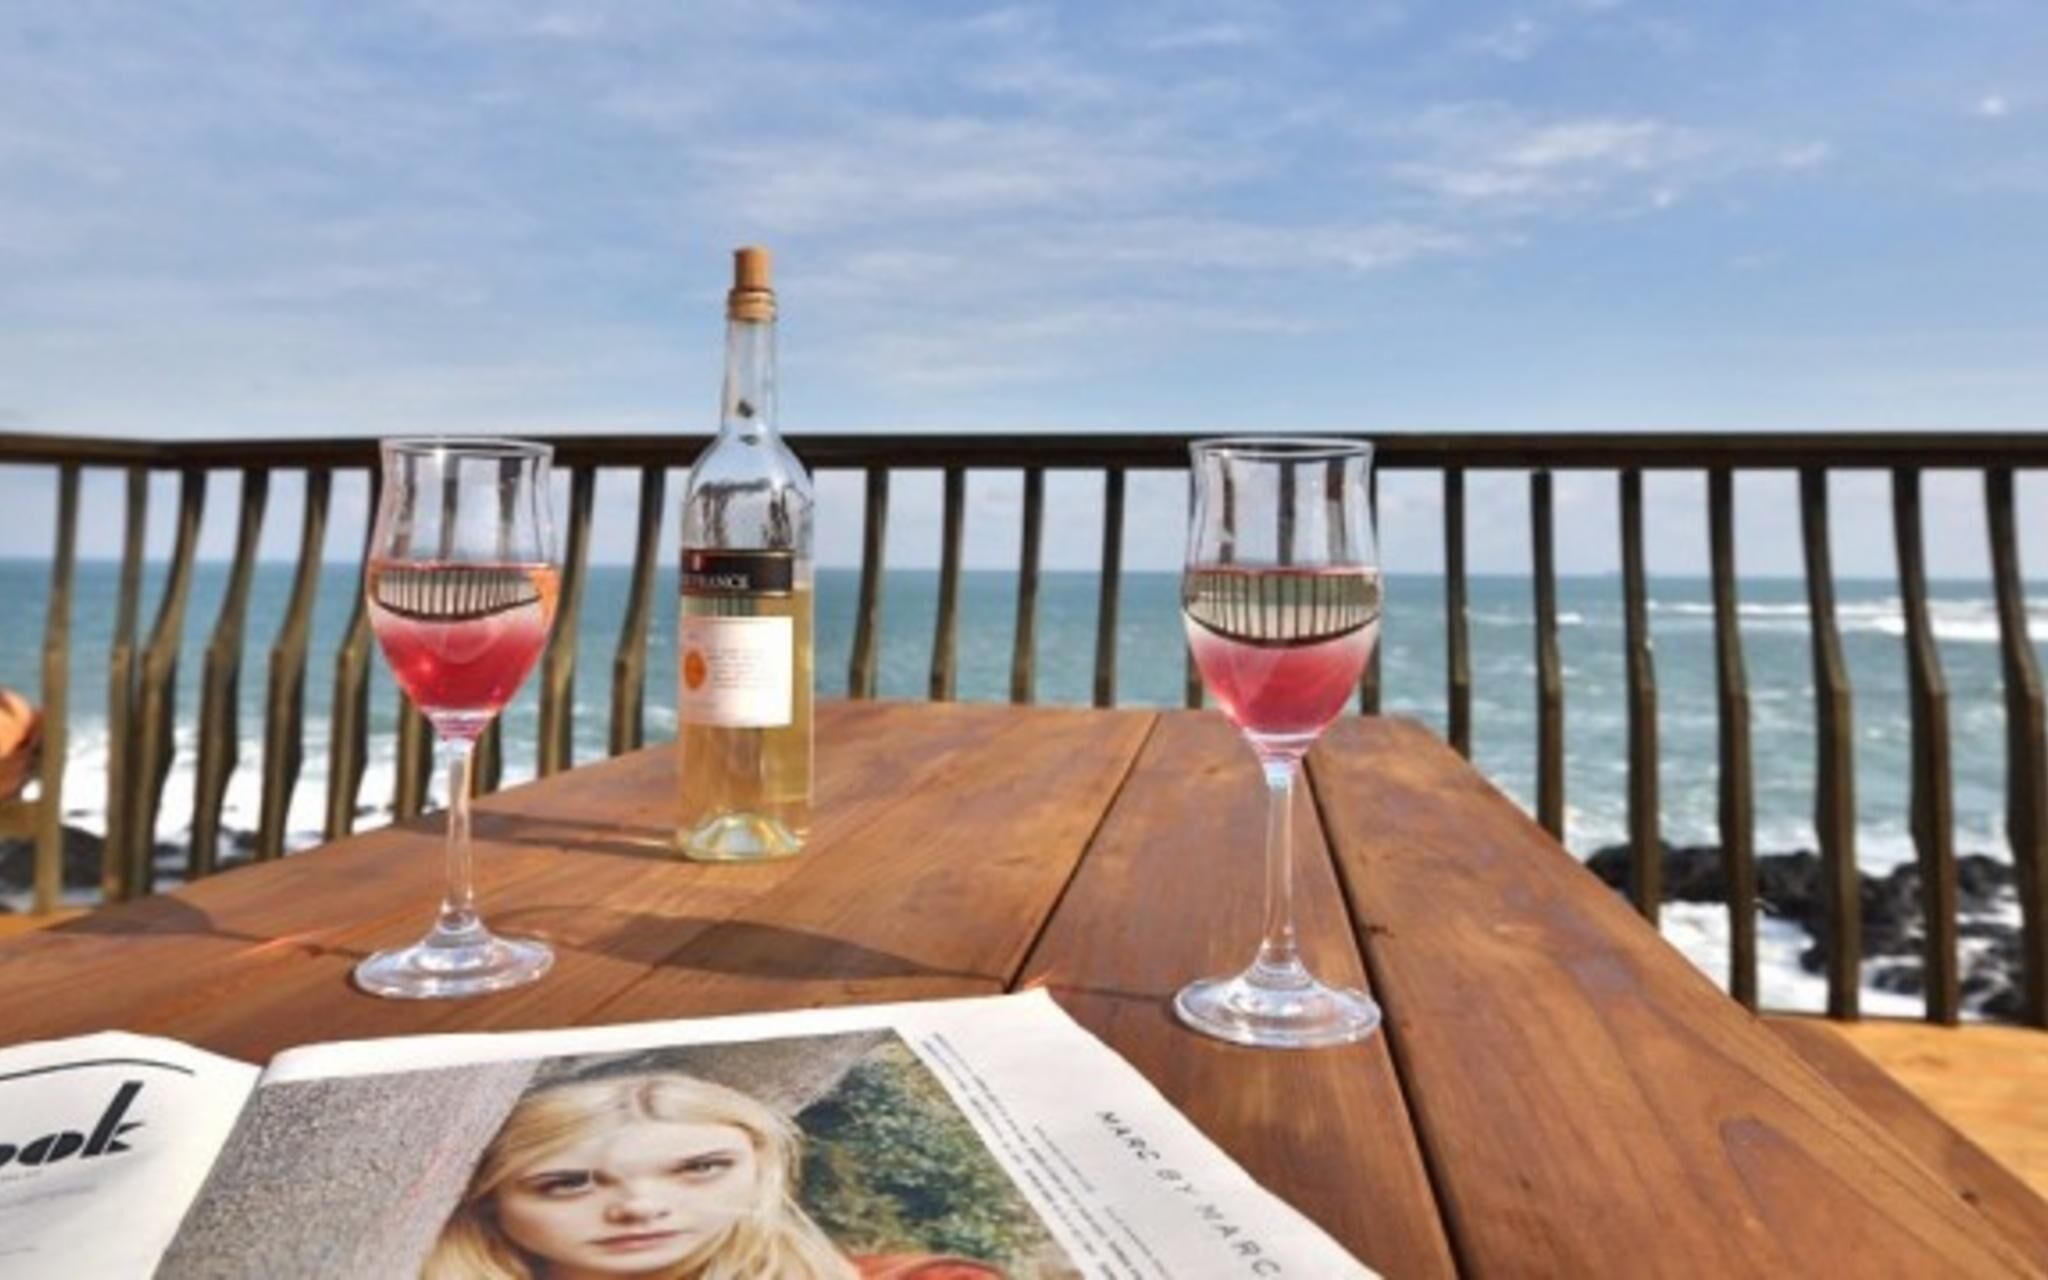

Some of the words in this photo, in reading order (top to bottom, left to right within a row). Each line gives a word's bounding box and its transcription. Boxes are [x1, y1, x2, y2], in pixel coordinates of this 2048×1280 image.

[0, 1080, 145, 1166] ok
[1096, 1110, 1161, 1161] MARC
[1155, 1168, 1194, 1194] BY
[1195, 1202, 1282, 1277] MARC
